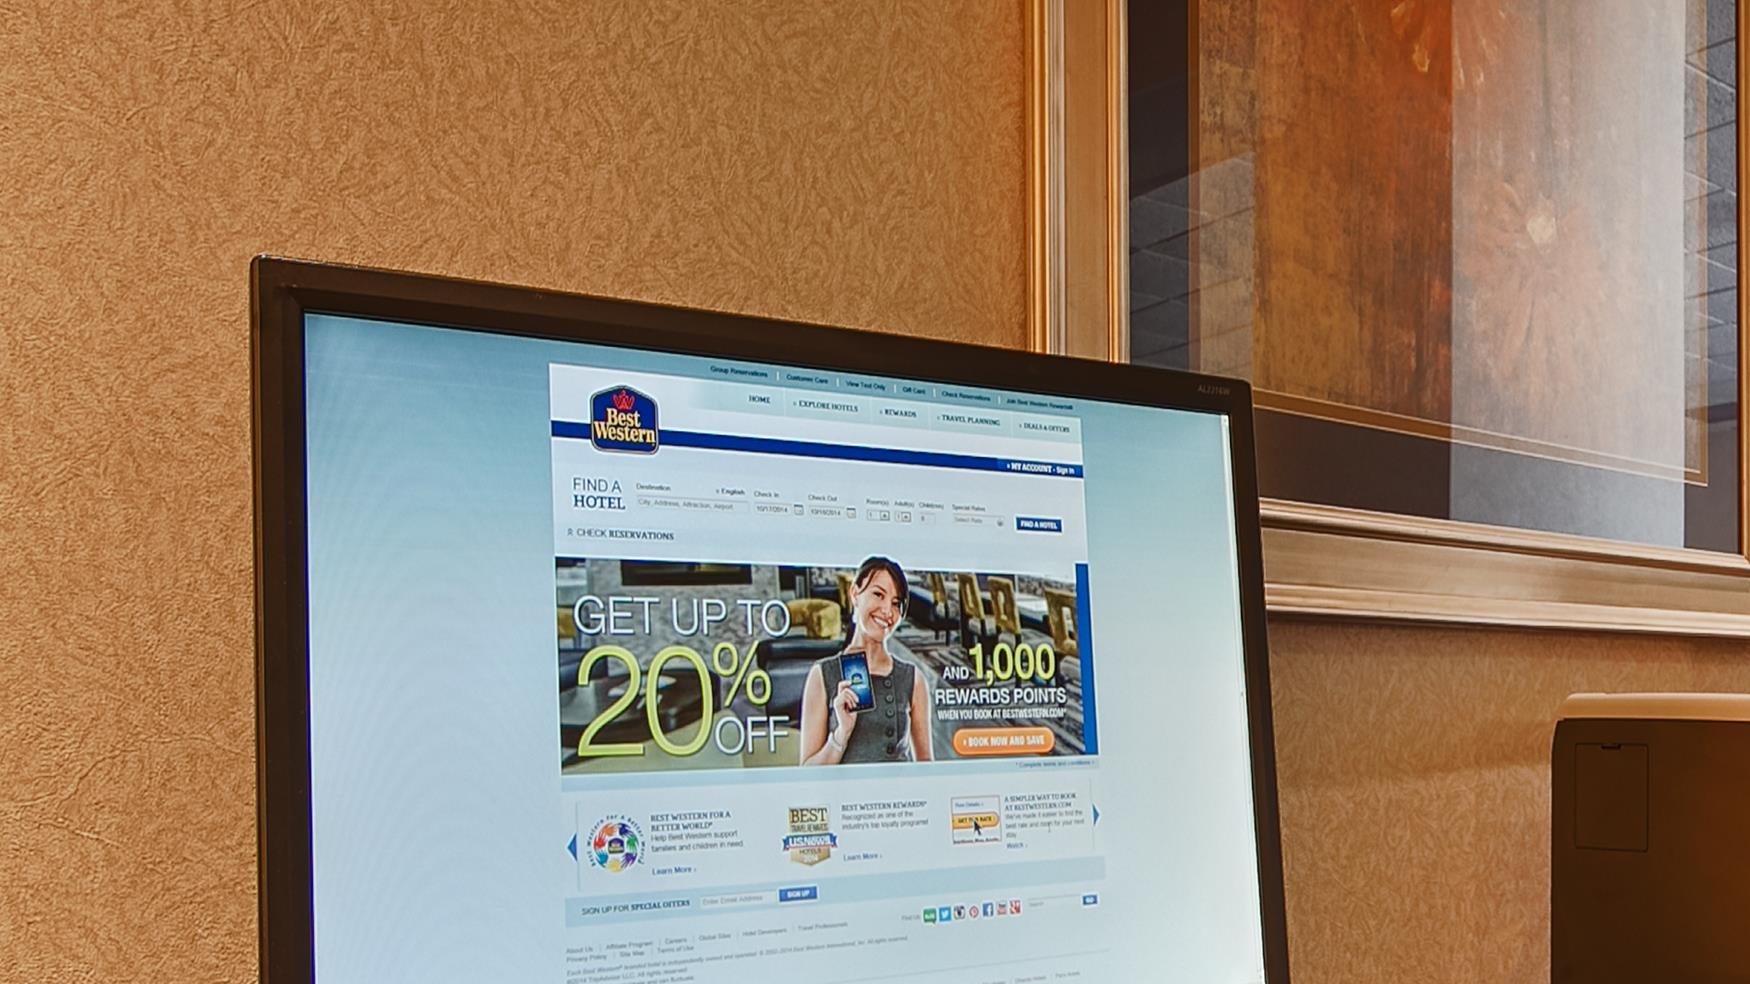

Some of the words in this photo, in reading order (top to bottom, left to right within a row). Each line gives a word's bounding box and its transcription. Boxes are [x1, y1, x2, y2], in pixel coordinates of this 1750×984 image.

[749, 395, 771, 404] HOME
[799, 400, 830, 410] EXPLORE
[831, 403, 858, 413] HOTELS
[884, 408, 917, 418] REWARDS
[606, 407, 641, 428] Best
[942, 414, 966, 424] TRAVEL
[968, 417, 1000, 426] PLANNING
[594, 421, 656, 443] Western
[572, 477, 608, 492] FIND
[611, 480, 622, 493] A
[573, 494, 626, 510] HOTEL
[576, 528, 607, 538] CHECK
[608, 529, 674, 541] RESERVATIONS
[573, 594, 659, 637] GET
[671, 597, 727, 637] UP
[733, 600, 791, 638] TO
[943, 667, 969, 680] AND
[969, 643, 1056, 686] 1,000
[576, 641, 772, 758] 20%
[935, 688, 1010, 705] REWARDS
[1014, 688, 1067, 704] POINTS
[937, 709, 959, 721] WHEN
[959, 709, 972, 720] YOU
[973, 709, 993, 720] BOOK
[714, 715, 790, 756] OFF
[968, 736, 989, 747] BOOK
[990, 736, 1009, 746] NOW
[1010, 736, 1025, 746] AND
[1026, 735, 1045, 745] SAVE
[841, 804, 858, 812] BEST
[860, 803, 891, 811] WESTERN
[650, 814, 669, 822] BEST
[671, 812, 708, 821] WESTERN
[790, 807, 827, 823] BEST
[651, 823, 681, 832] BETTER
[582, 906, 601, 915] SIGN
[602, 905, 613, 914] UP
[613, 904, 630, 913] FOR
[631, 902, 661, 911] SPECIAL
